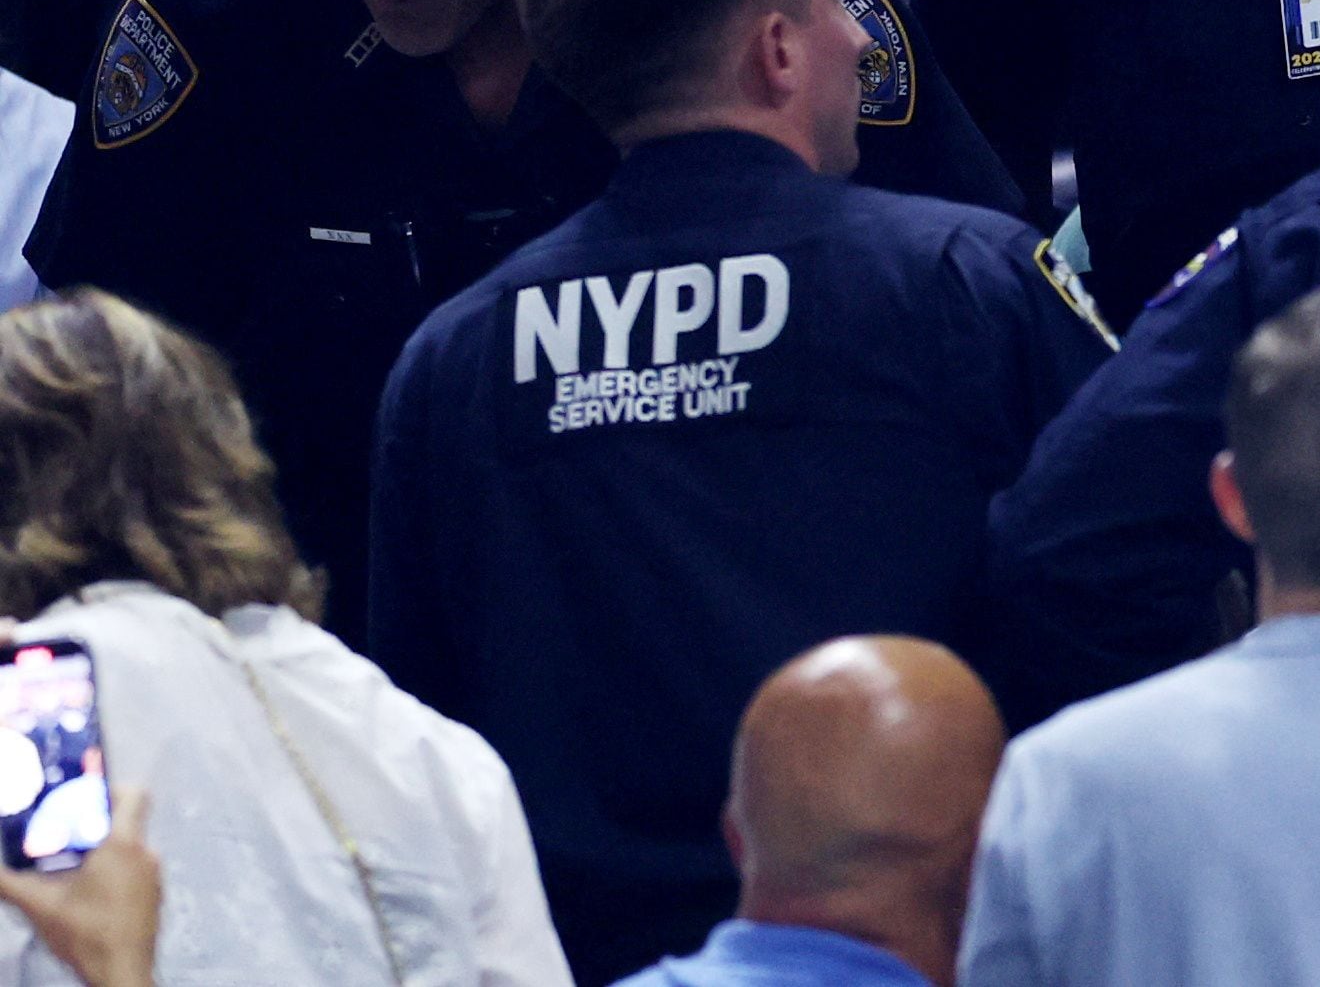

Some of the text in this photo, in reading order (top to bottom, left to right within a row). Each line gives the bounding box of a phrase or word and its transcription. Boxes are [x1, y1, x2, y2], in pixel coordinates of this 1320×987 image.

[120, 13, 182, 90] DEPARTMENT
[136, 10, 175, 60] POLICE
[108, 97, 170, 138] NEW YORK
[861, 104, 882, 115] OF
[514, 253, 790, 384] NYPD
[555, 356, 739, 403] EMERGENCY
[548, 382, 751, 433] SERVICE UNIT
